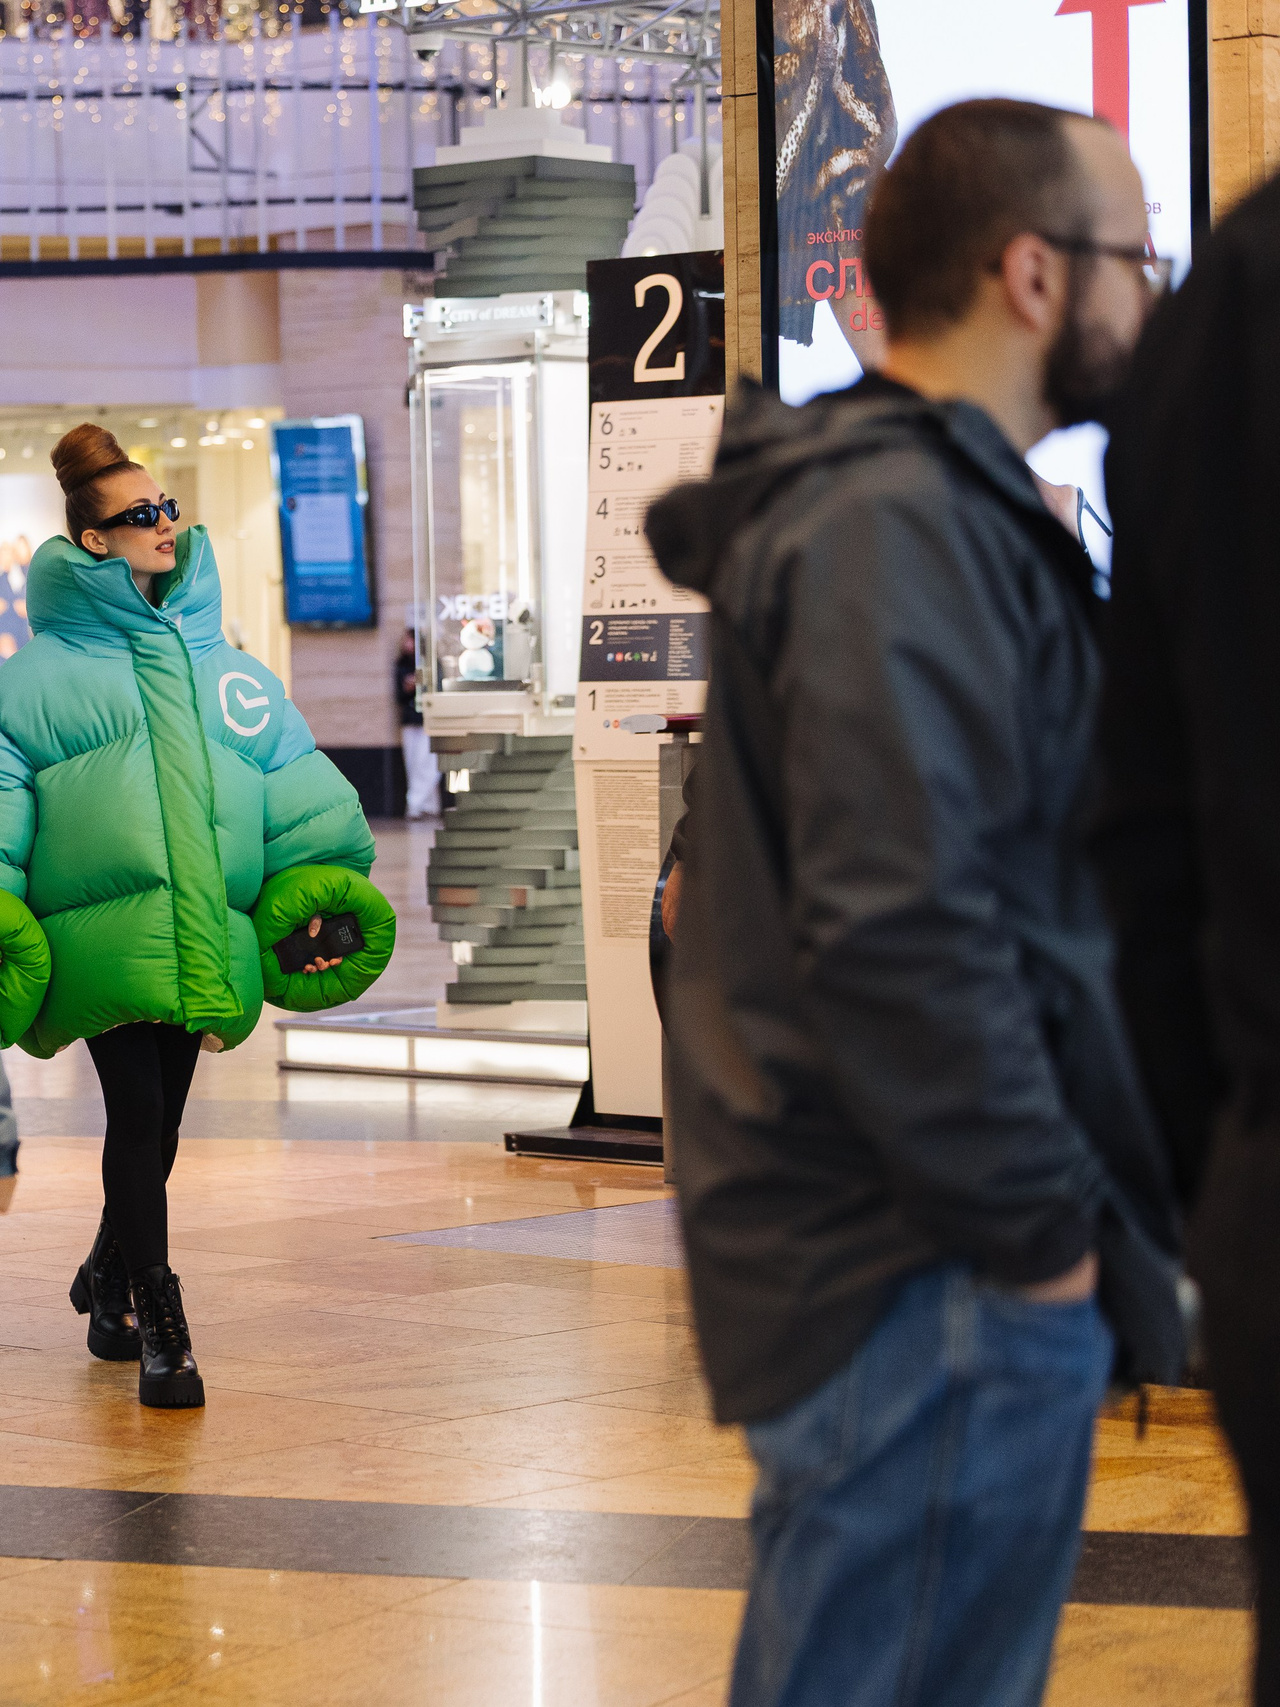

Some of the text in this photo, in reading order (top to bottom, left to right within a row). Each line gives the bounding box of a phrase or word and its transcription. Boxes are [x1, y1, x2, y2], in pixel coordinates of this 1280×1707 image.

[449, 308, 476, 323] CITY
[493, 304, 539, 320] DREAM
[633, 273, 685, 383] 2
[601, 413, 613, 435] 6
[600, 447, 611, 470] 5
[596, 498, 609, 519] 4
[594, 556, 606, 578] 3
[589, 620, 605, 645] 2
[588, 689, 597, 711] 1
